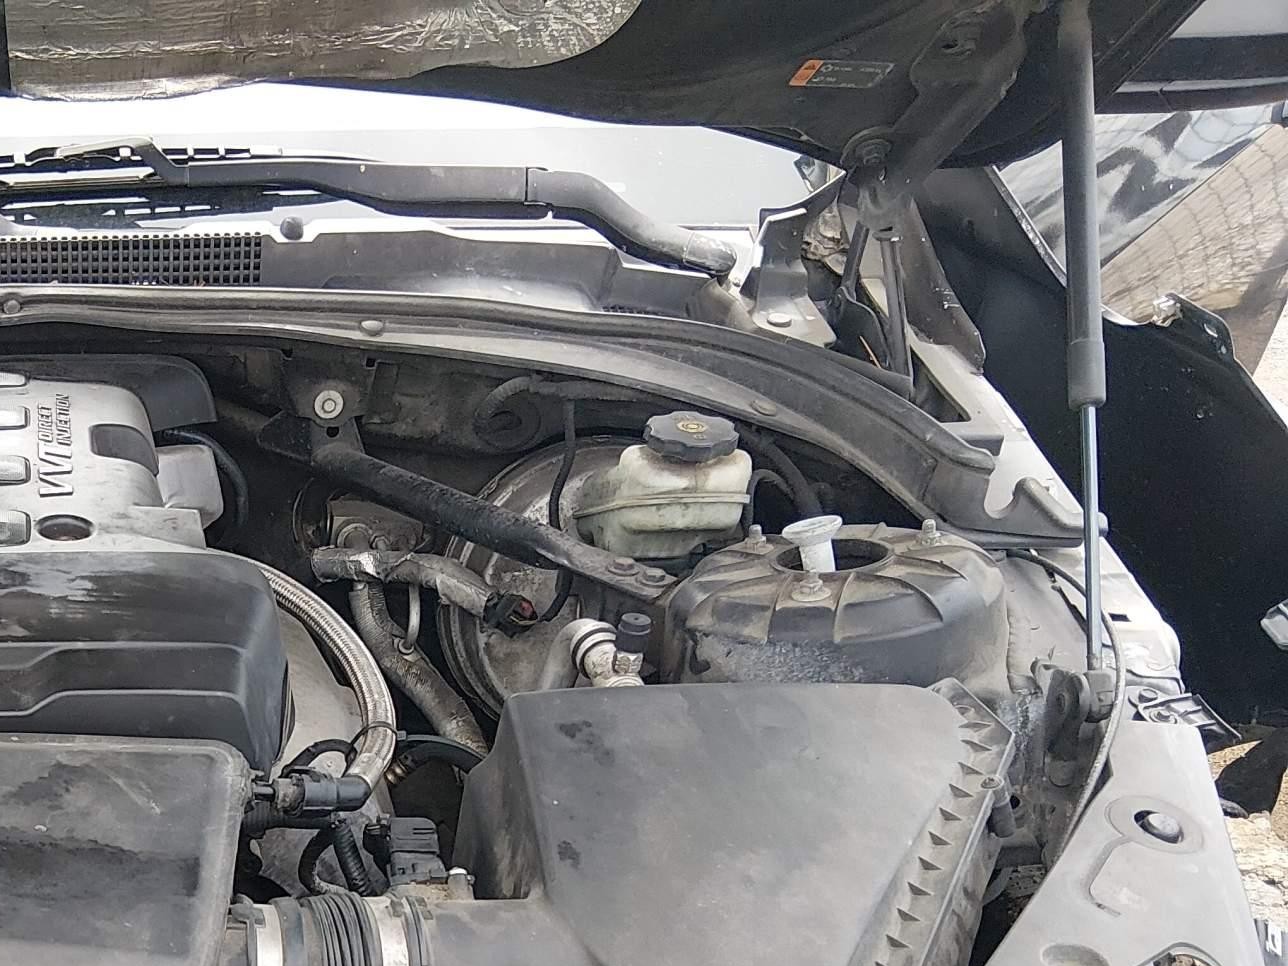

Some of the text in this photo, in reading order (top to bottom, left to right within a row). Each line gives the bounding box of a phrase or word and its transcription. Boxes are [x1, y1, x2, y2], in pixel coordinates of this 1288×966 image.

[37, 403, 53, 443] DIRECT
[55, 393, 72, 447] INJECTION
[37, 442, 74, 498] VVT
